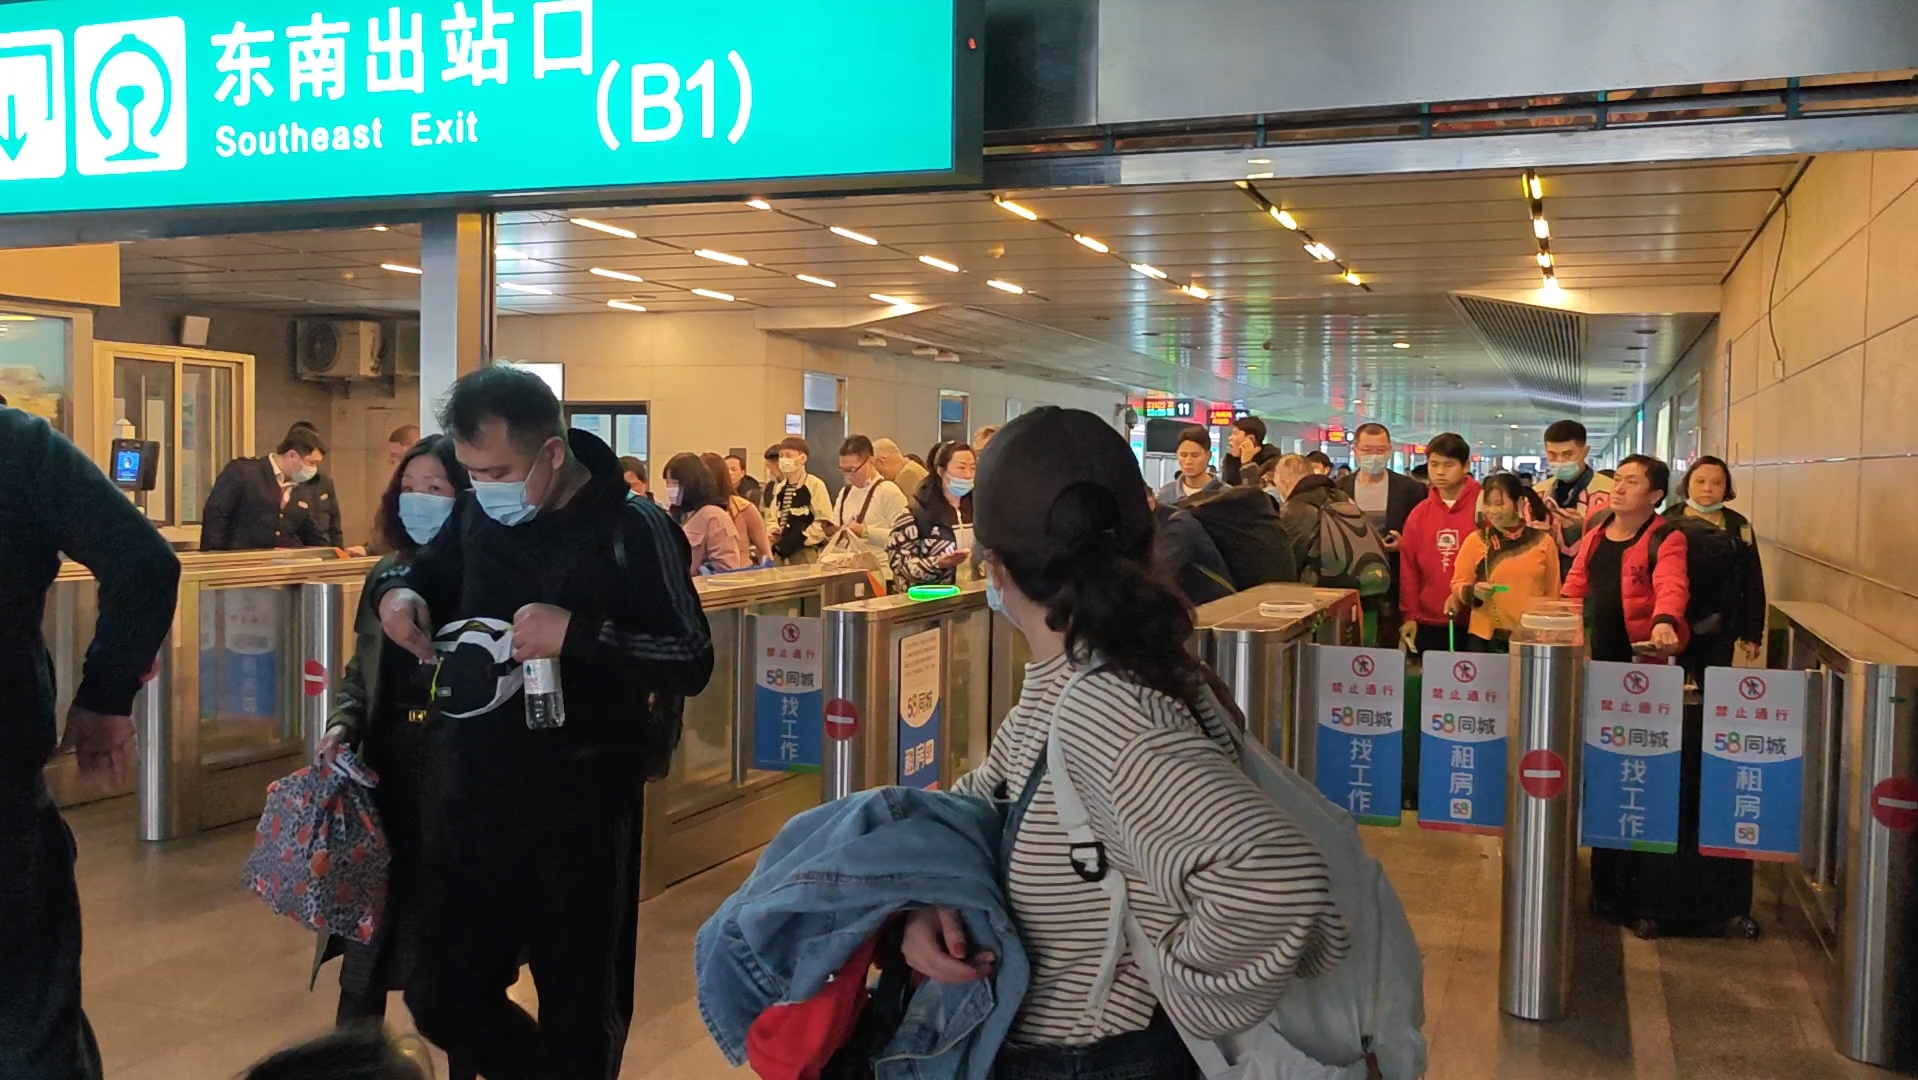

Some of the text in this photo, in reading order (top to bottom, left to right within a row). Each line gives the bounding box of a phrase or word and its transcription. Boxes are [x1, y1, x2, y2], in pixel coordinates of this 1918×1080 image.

[210, 0, 593, 107] 东南出站口
[597, 49, 752, 151] (B1)
[215, 110, 478, 158] Southeast Exit
[1177, 403, 1190, 416] 11
[766, 668, 815, 687] 58同城
[1331, 682, 1394, 696] 禁止通行
[1432, 688, 1497, 703] 禁止通行
[1601, 699, 1671, 716] 禁止通行
[1331, 706, 1393, 728] 58同城
[1431, 712, 1496, 735] 58同城
[1715, 705, 1789, 722] 禁止通行
[780, 696, 799, 760] 找工作
[1600, 725, 1669, 749] 58同城
[1714, 731, 1787, 756] 58同城
[1348, 738, 1373, 813] 找工作
[1449, 745, 1475, 796] 租房
[1618, 759, 1647, 838] 找工作
[1734, 766, 1763, 820] 租房
